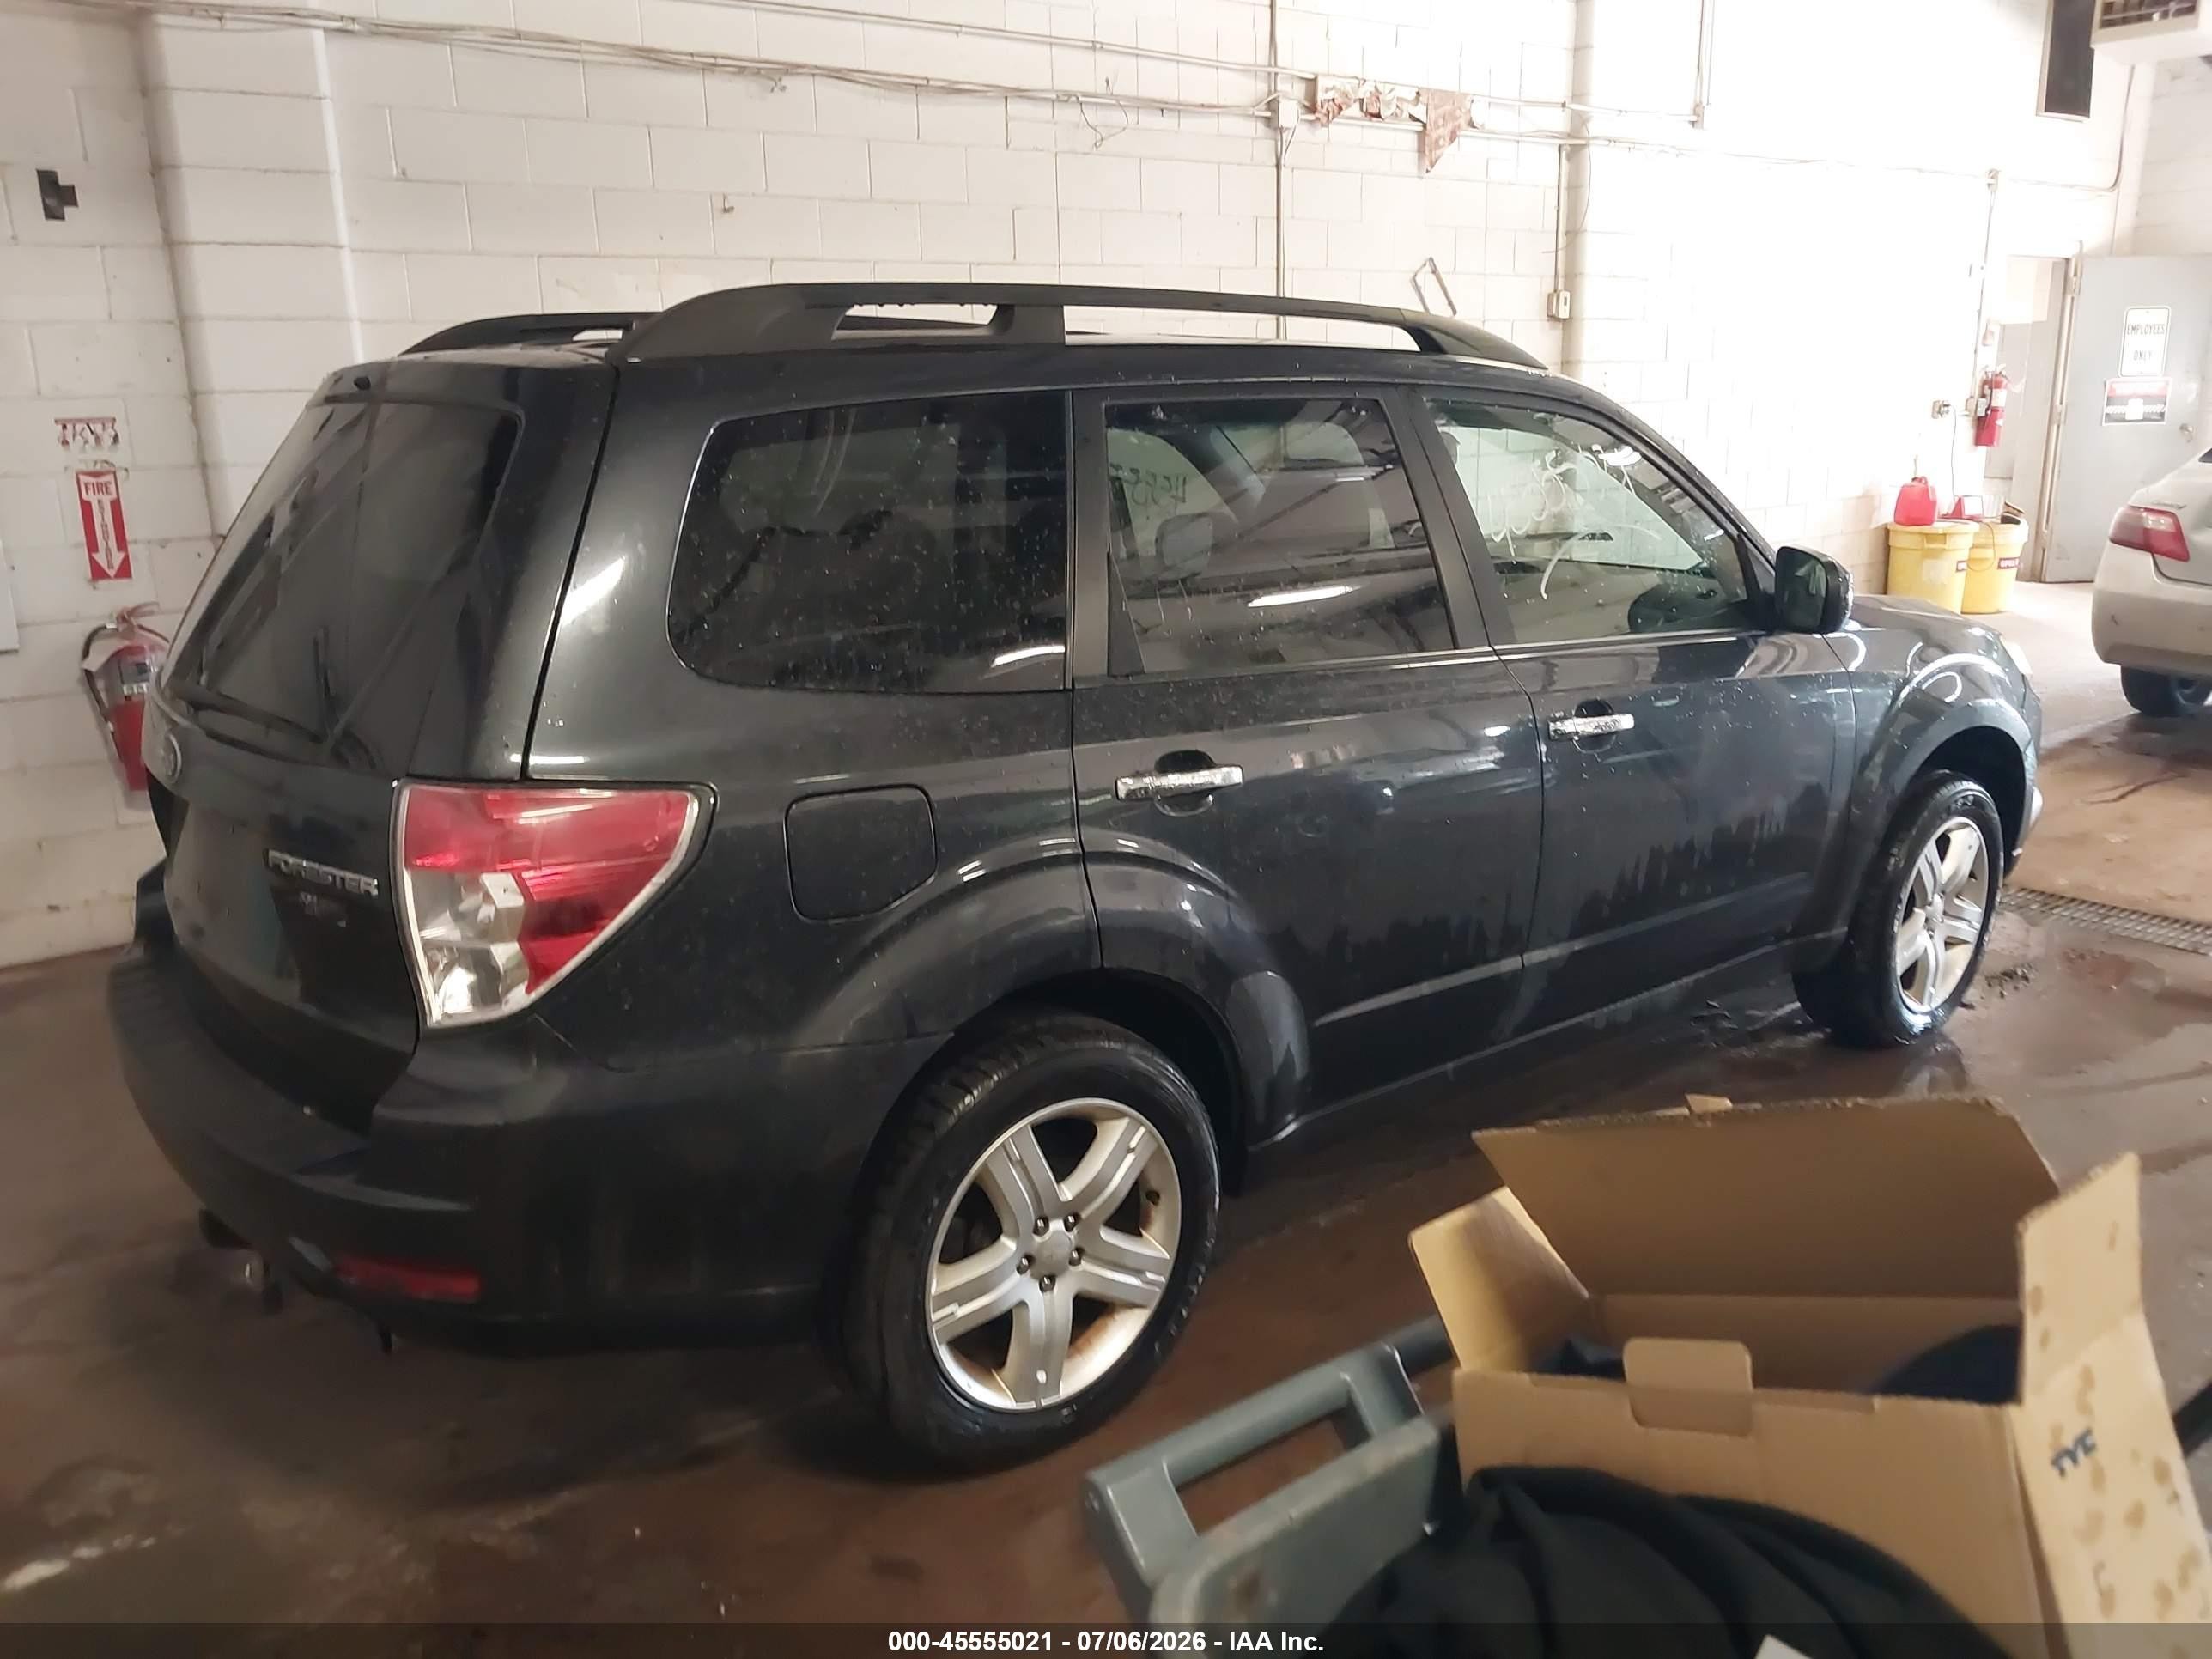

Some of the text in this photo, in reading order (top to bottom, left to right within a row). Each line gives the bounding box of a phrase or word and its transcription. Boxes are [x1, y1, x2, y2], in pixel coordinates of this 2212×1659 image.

[2127, 323, 2166, 335] EMPLOYEES
[2133, 349, 2152, 361] ONLY
[84, 482, 112, 495] FIRE
